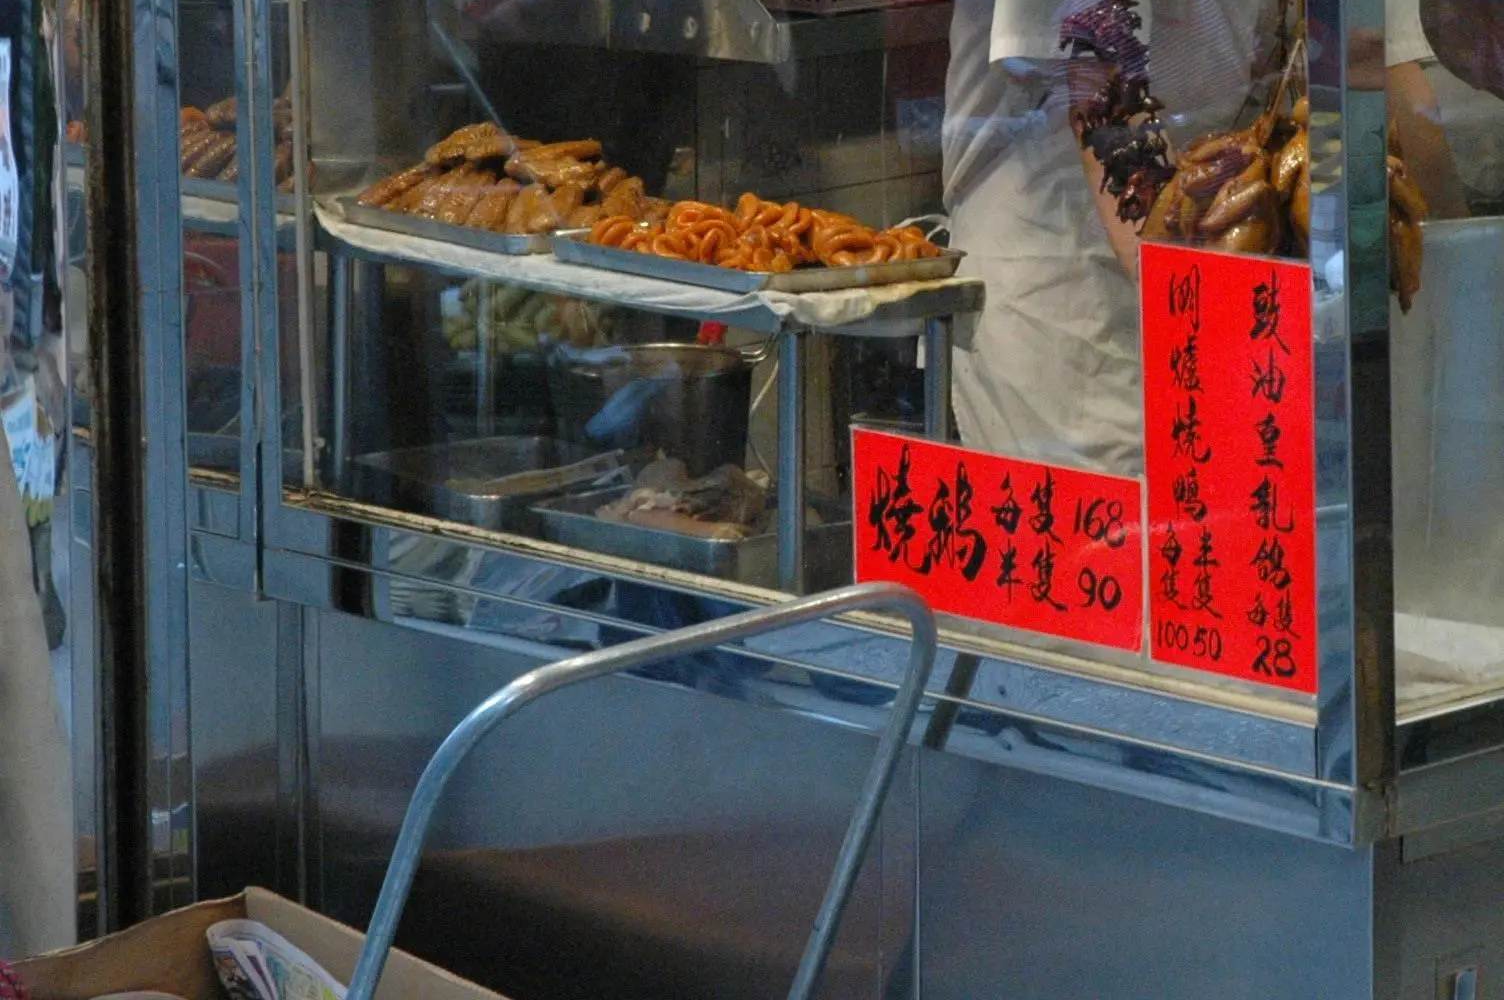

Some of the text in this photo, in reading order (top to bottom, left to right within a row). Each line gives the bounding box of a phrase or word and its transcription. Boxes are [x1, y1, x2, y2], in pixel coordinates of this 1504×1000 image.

[1074, 499, 1126, 548] 168
[1077, 567, 1123, 612] 90
[1194, 627, 1223, 660] 50
[1253, 639, 1296, 678] 28
